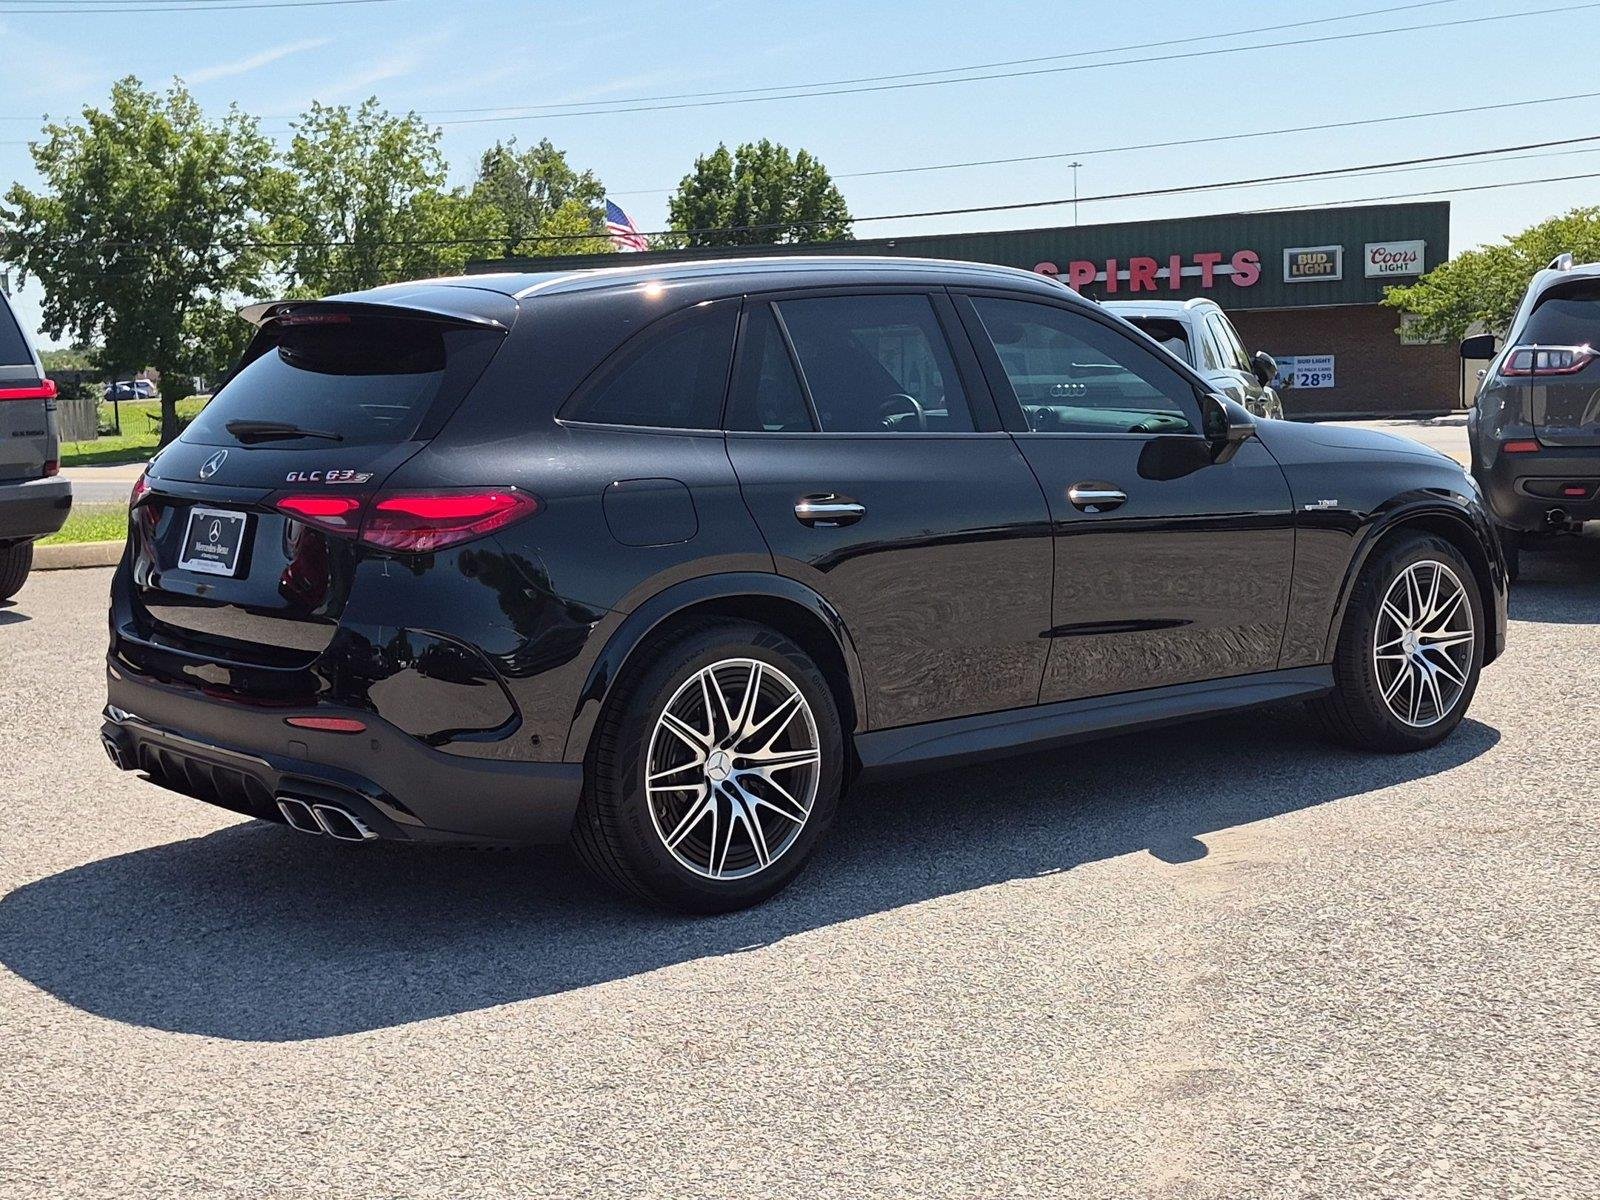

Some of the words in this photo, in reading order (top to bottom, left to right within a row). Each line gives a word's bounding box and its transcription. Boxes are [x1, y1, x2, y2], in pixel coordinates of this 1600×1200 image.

[1297, 253, 1328, 264] BUD
[1370, 247, 1418, 264] Coors
[1292, 263, 1333, 275] LIGHT
[1379, 262, 1409, 272] LIGHT
[285, 471, 322, 482] GLC
